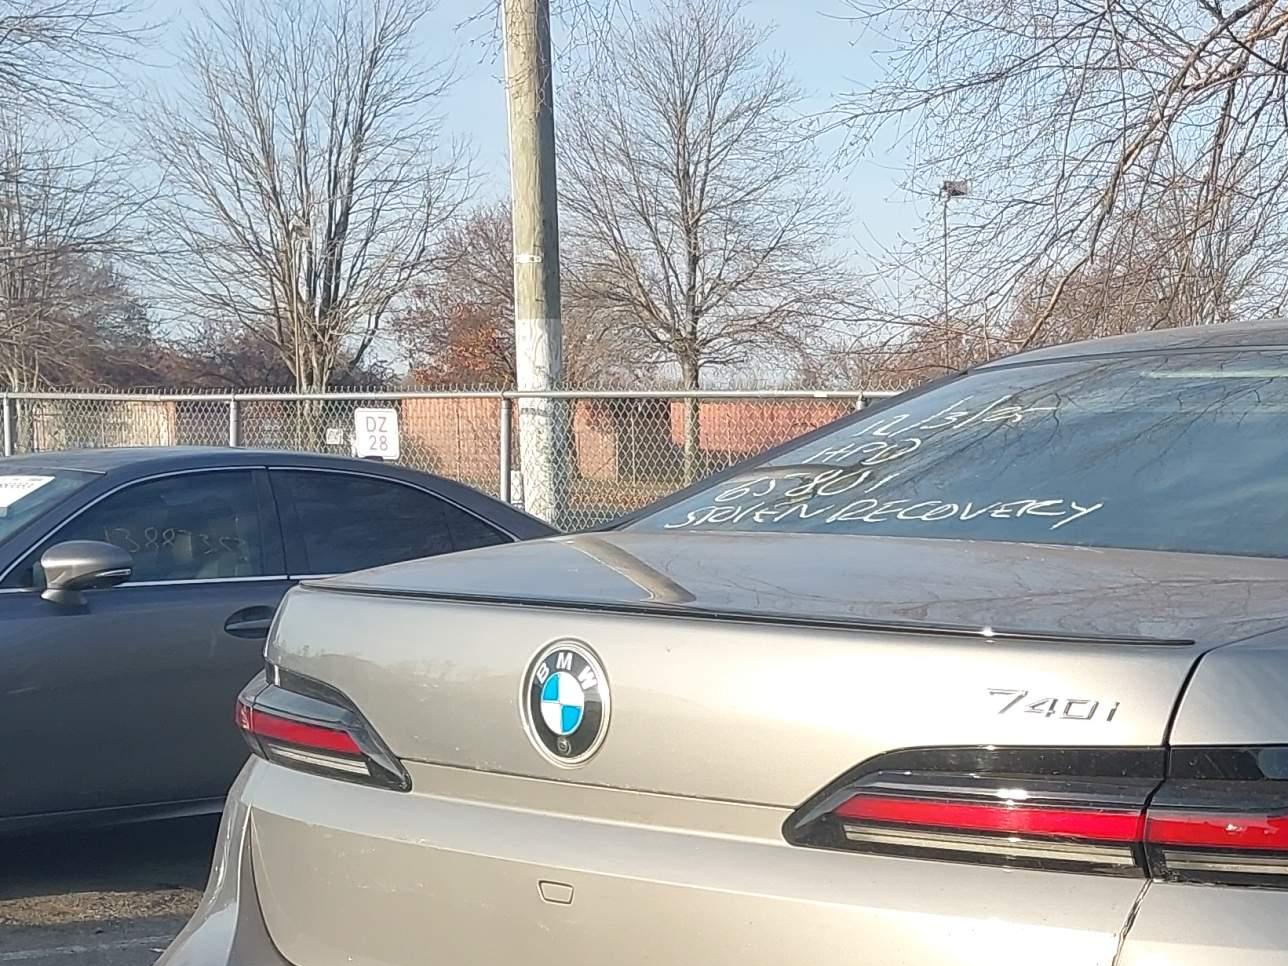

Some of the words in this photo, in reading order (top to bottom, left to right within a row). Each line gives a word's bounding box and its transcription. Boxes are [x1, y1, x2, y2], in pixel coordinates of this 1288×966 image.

[365, 416, 388, 433] DZ
[369, 434, 389, 452] 28
[662, 501, 836, 530] STOLEN
[824, 498, 1103, 531] RECOVERY
[536, 651, 599, 691] BMW
[986, 687, 1121, 723] 740i
